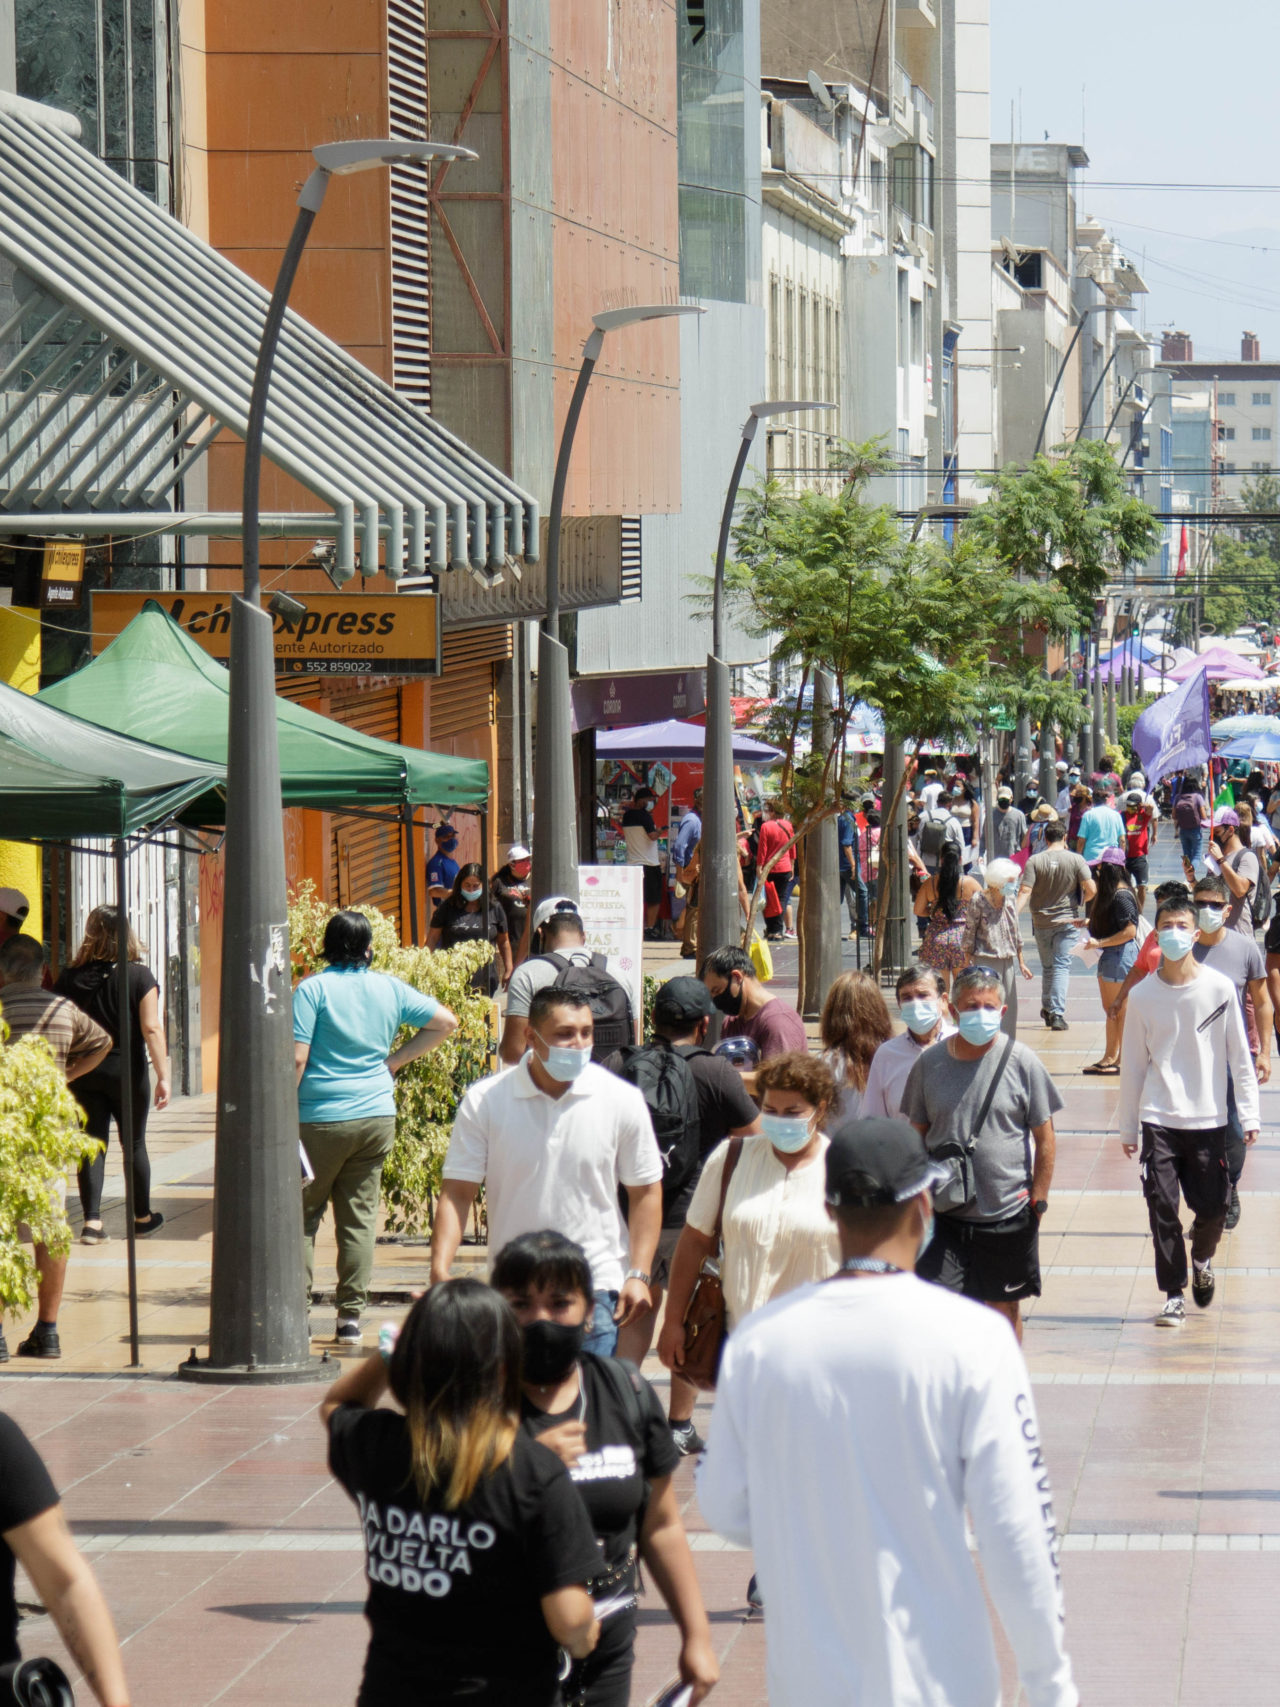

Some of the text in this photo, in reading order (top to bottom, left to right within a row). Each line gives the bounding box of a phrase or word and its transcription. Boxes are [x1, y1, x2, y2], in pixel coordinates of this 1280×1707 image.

[275, 641, 384, 655] ente Autorizado
[306, 661, 372, 673] 552 859022
[603, 699, 621, 715] CORONA
[386, 1506, 497, 1550] DARLO
[366, 1528, 472, 1576] VUELTA
